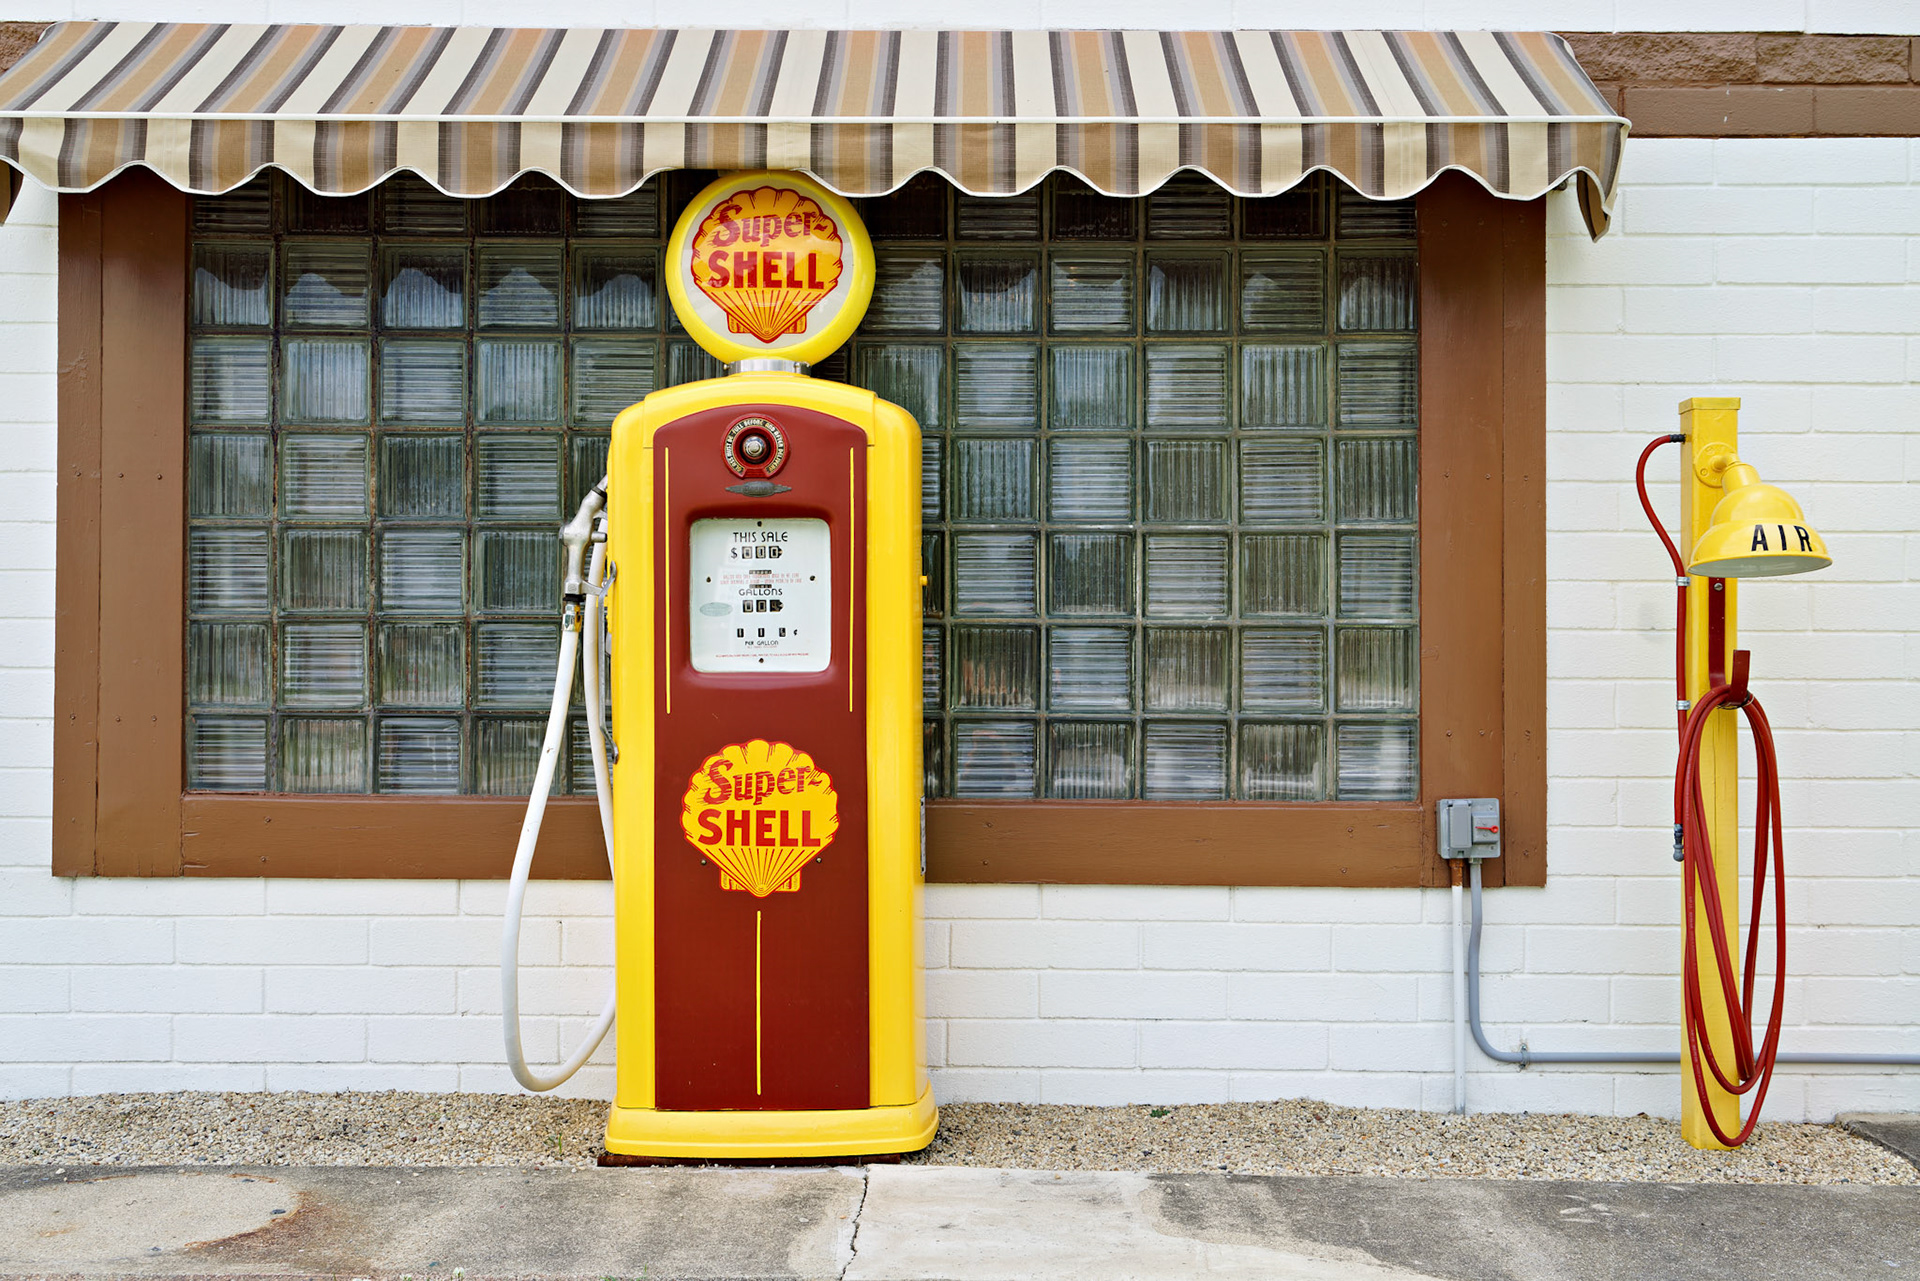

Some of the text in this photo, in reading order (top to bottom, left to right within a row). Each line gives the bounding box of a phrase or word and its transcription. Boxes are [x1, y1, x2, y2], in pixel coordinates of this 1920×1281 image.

[708, 250, 825, 290] SHELL
[733, 531, 788, 543] THIS SALE
[1751, 524, 1813, 552] AIR
[738, 588, 783, 596] GALLONS
[698, 808, 821, 847] SHELL
